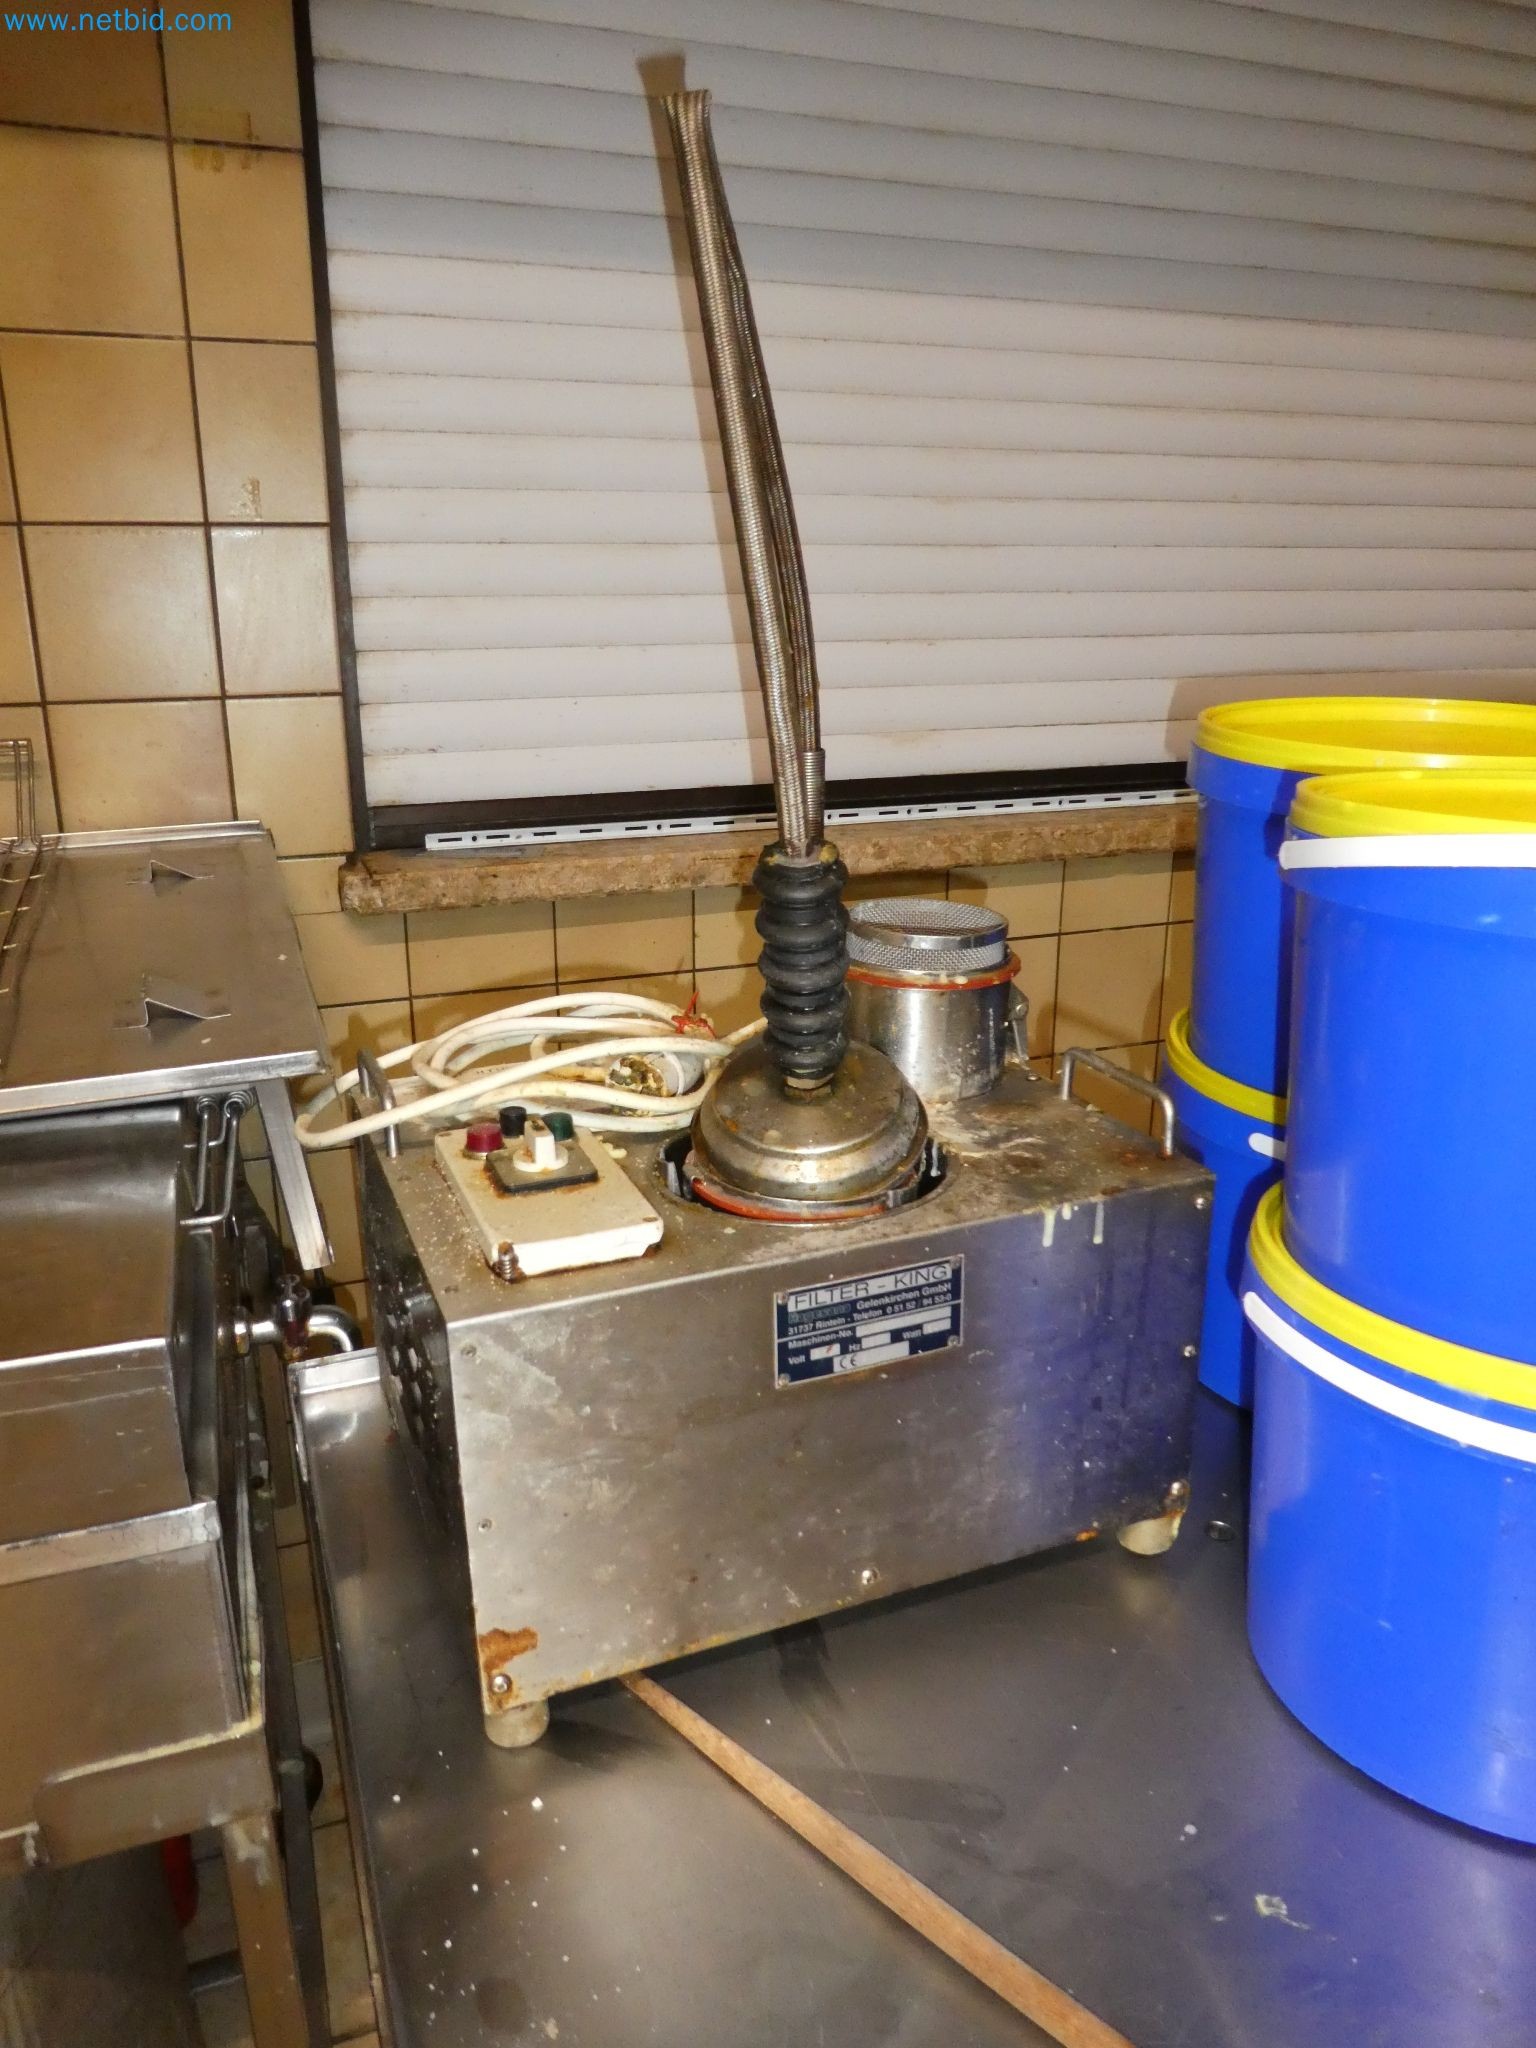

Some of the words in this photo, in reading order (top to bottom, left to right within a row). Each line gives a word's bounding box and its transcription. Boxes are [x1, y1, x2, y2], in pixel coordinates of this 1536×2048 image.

[794, 1281, 869, 1309] FILTER
[894, 1265, 948, 1289] KING
[922, 1281, 952, 1296] GmbH
[788, 1355, 806, 1365] Volt
